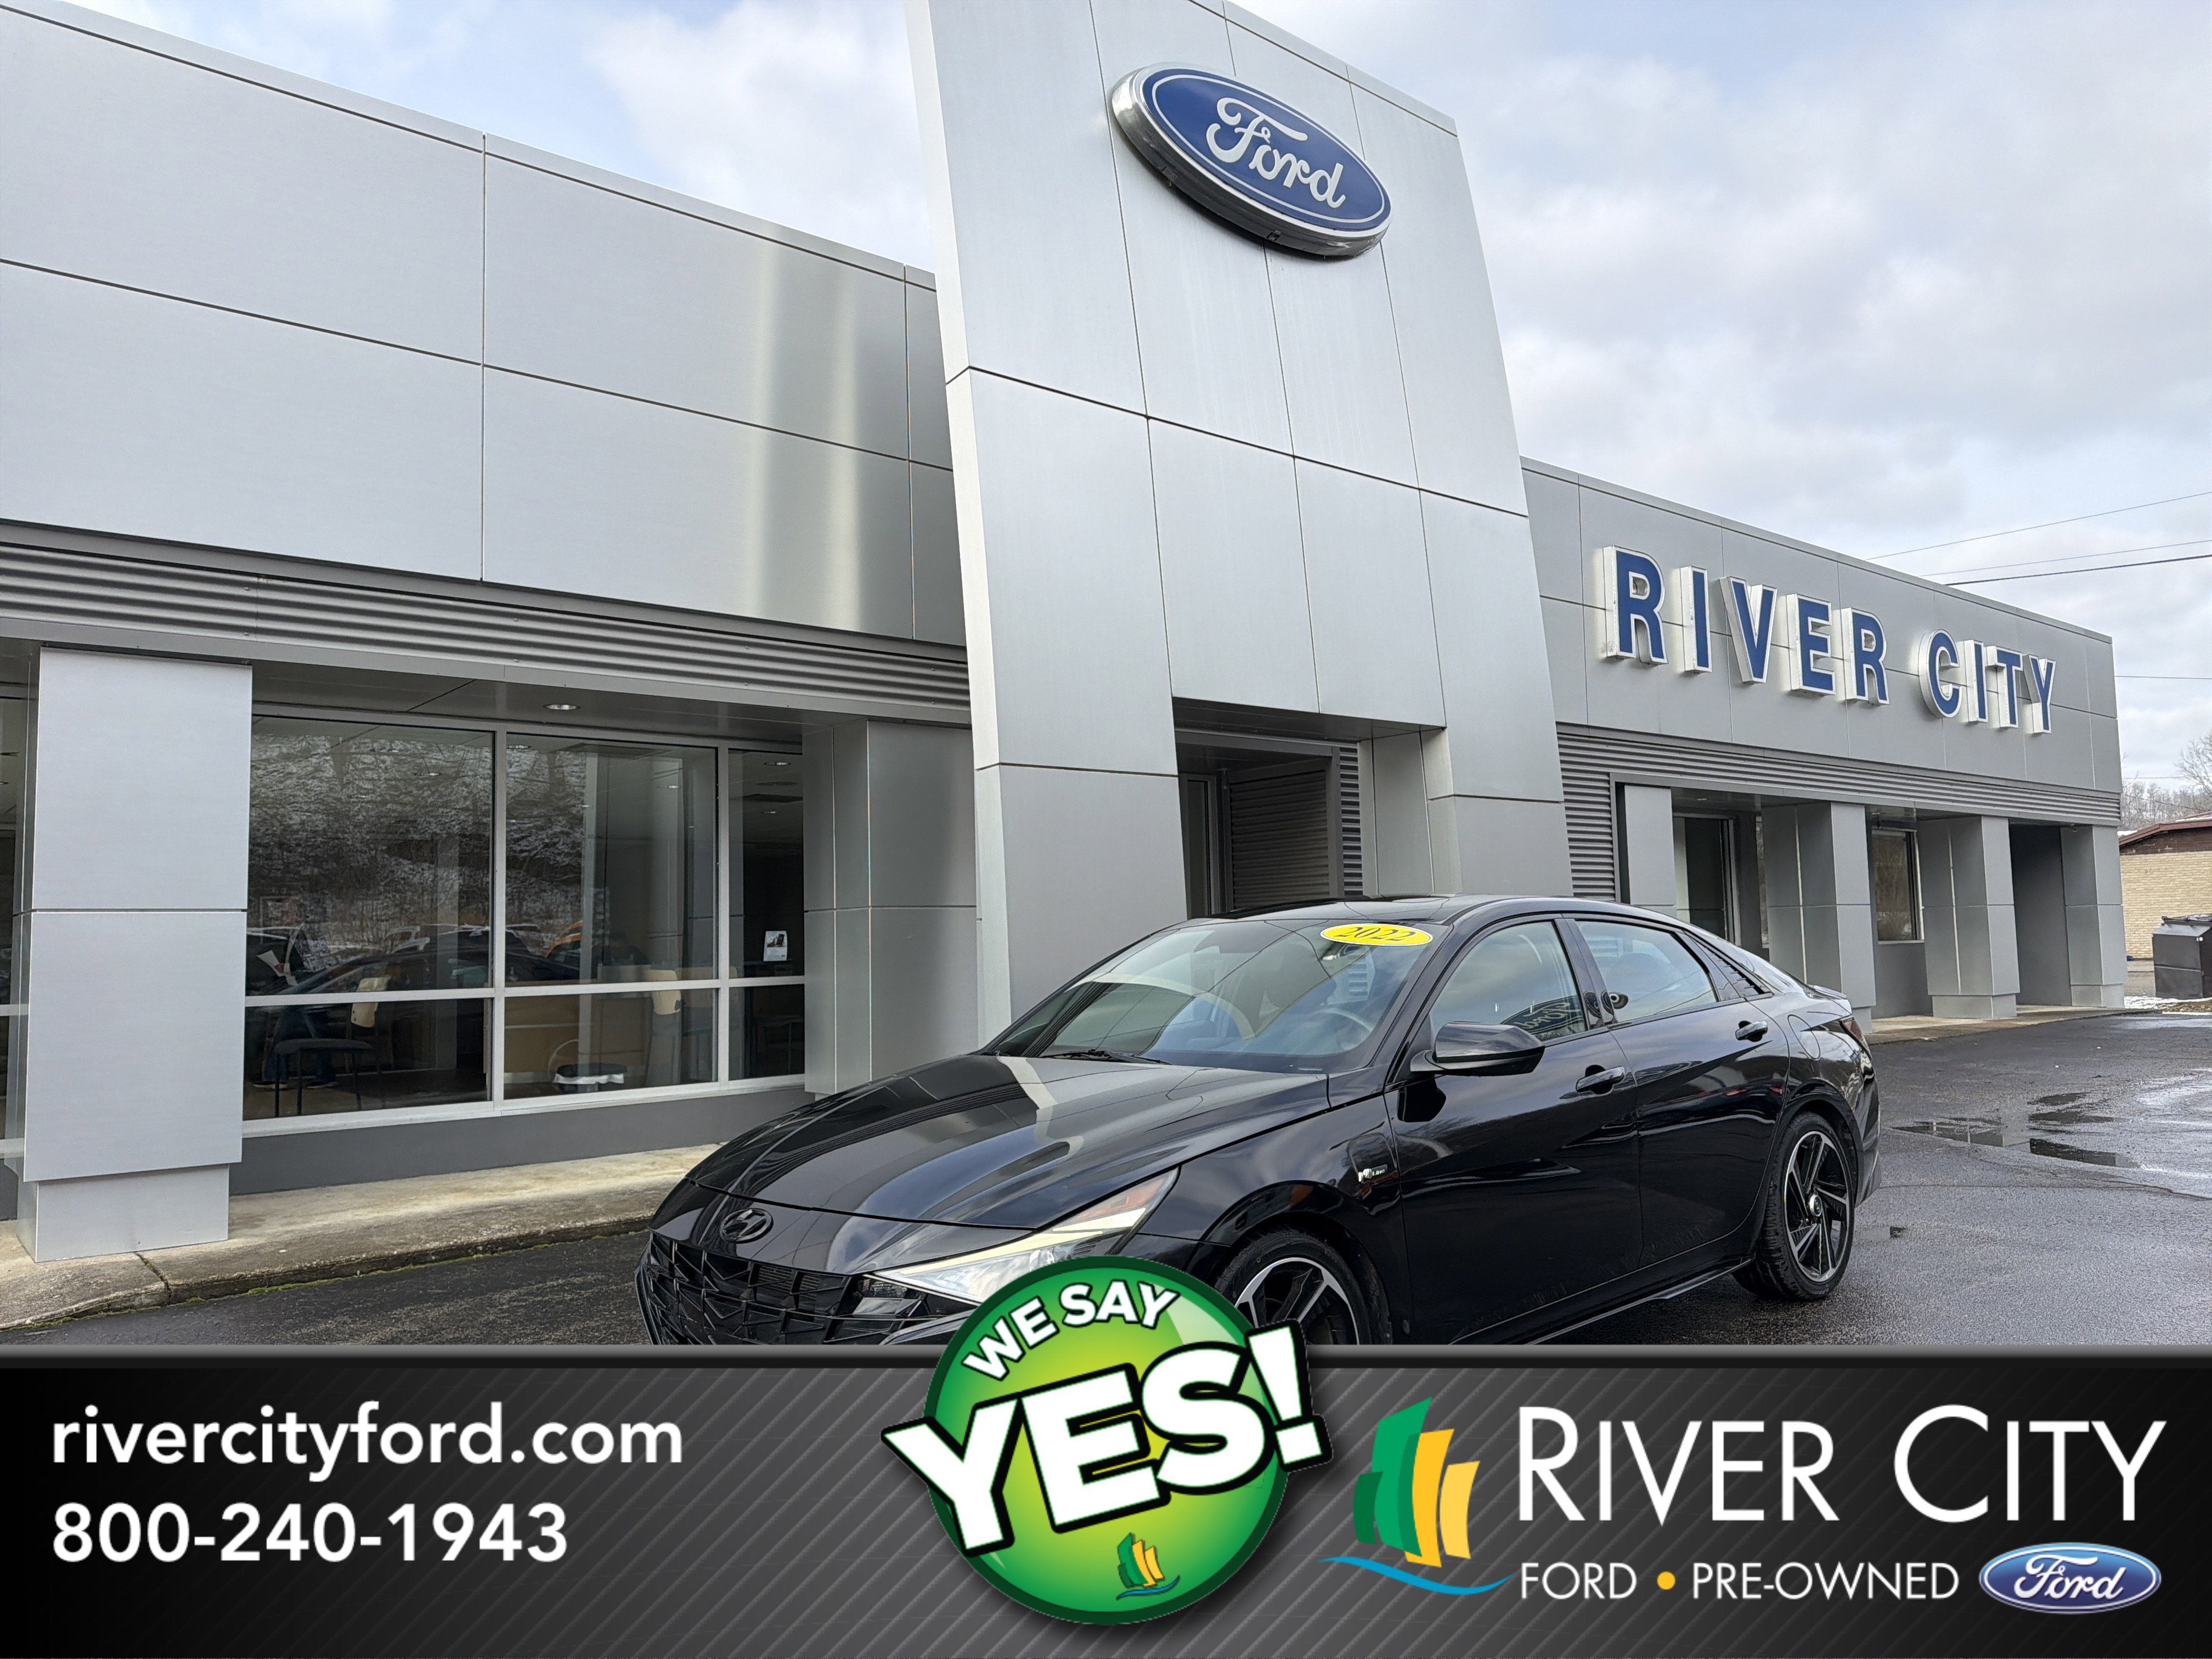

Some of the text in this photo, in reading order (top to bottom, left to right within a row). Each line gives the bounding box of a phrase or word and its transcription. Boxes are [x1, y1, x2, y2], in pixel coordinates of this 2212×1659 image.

[1206, 97, 1346, 208] Ford
[1606, 546, 2056, 734] RIVER CITY
[1333, 927, 1417, 941] 2022
